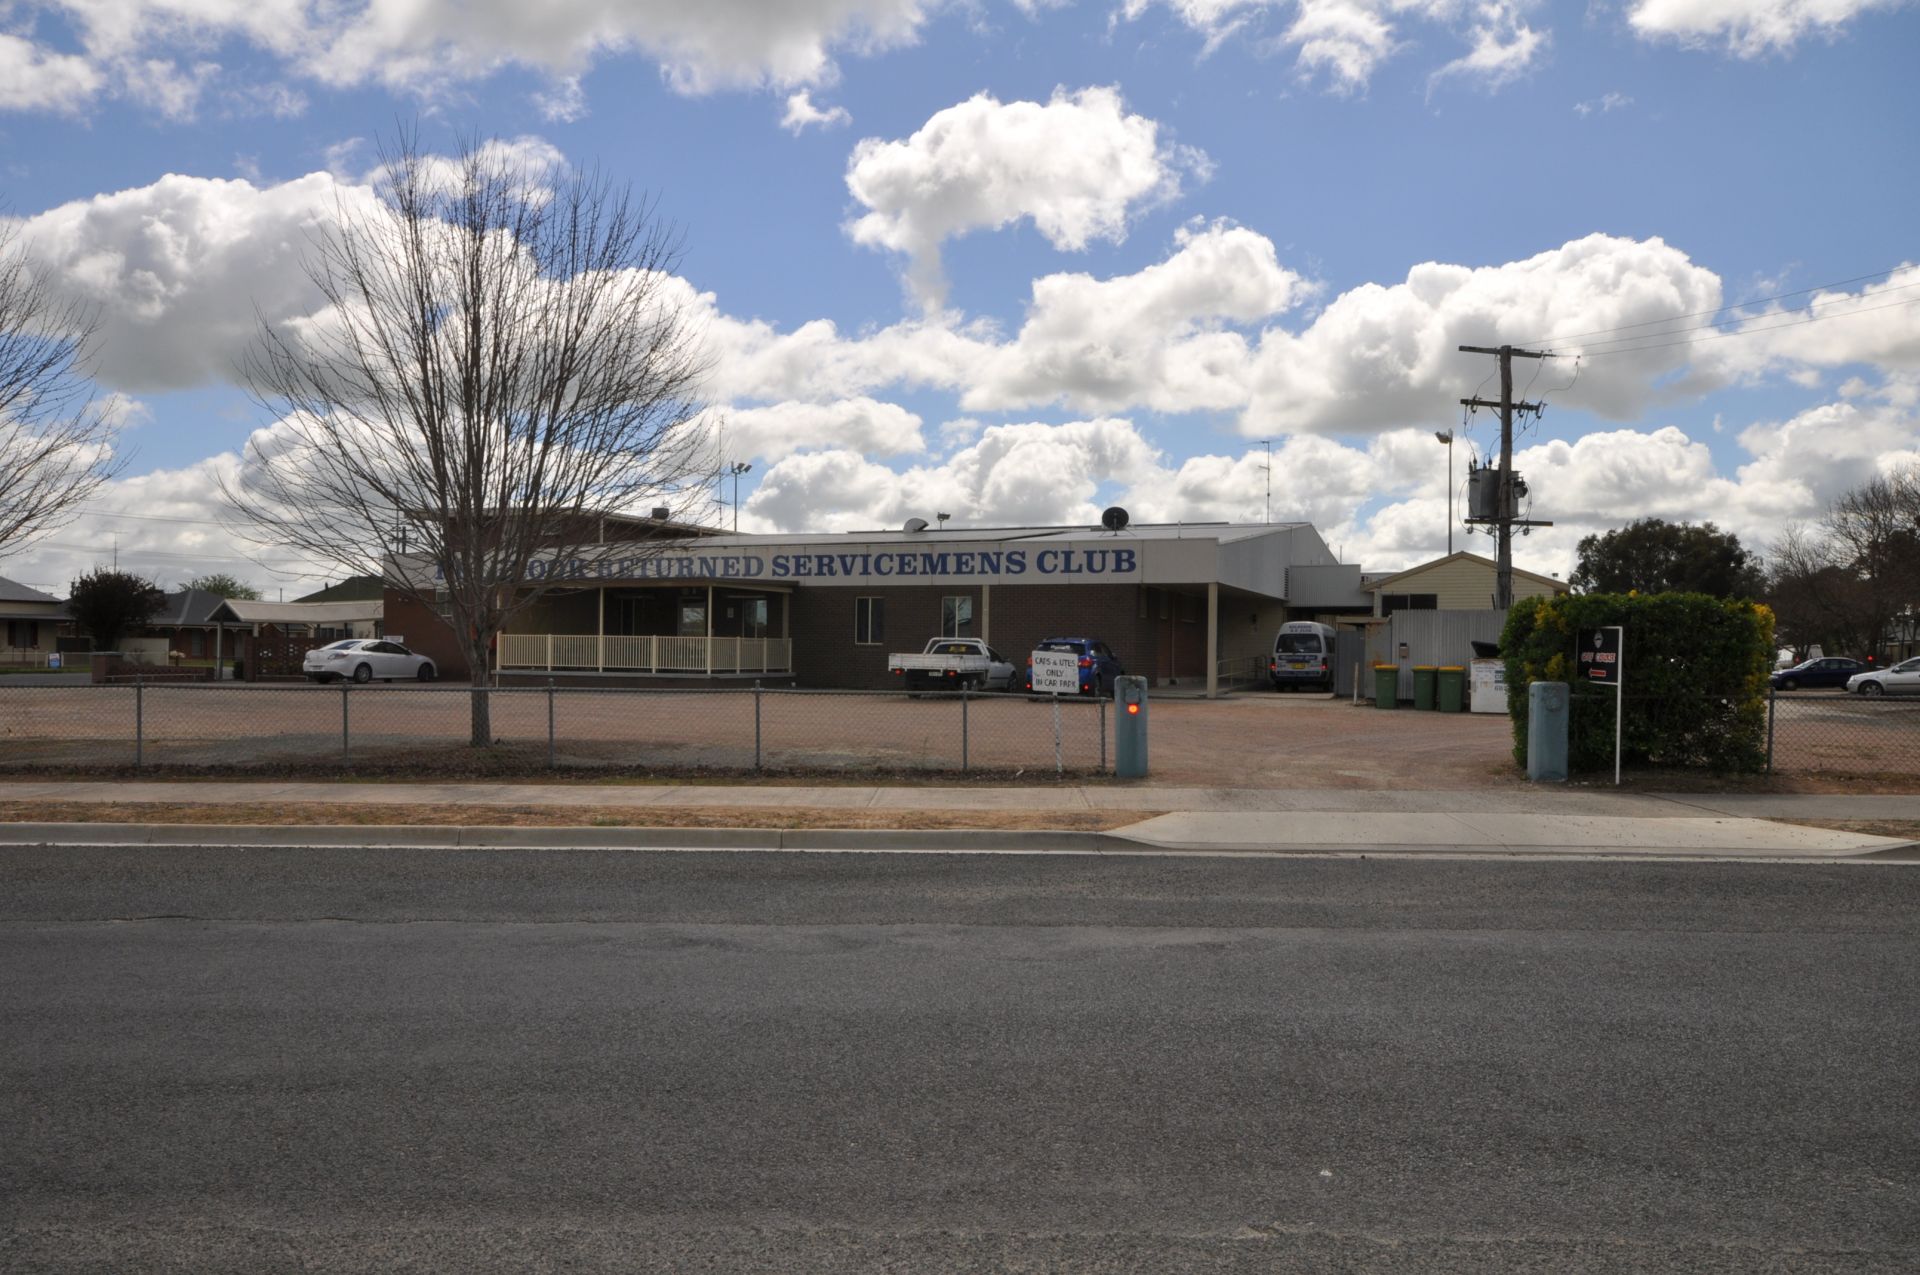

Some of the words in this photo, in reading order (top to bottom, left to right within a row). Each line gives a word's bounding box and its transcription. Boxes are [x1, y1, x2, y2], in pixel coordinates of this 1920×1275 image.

[597, 554, 764, 579] RETURNED
[771, 549, 1026, 577] SERVICEMENS
[1036, 548, 1137, 574] CLUB
[1035, 657, 1052, 666] CARS
[1059, 658, 1076, 667] UTES
[1046, 669, 1064, 677] ONLY
[1036, 678, 1043, 686] IN
[1044, 678, 1058, 687] CAR
[1059, 679, 1076, 688] PARK
